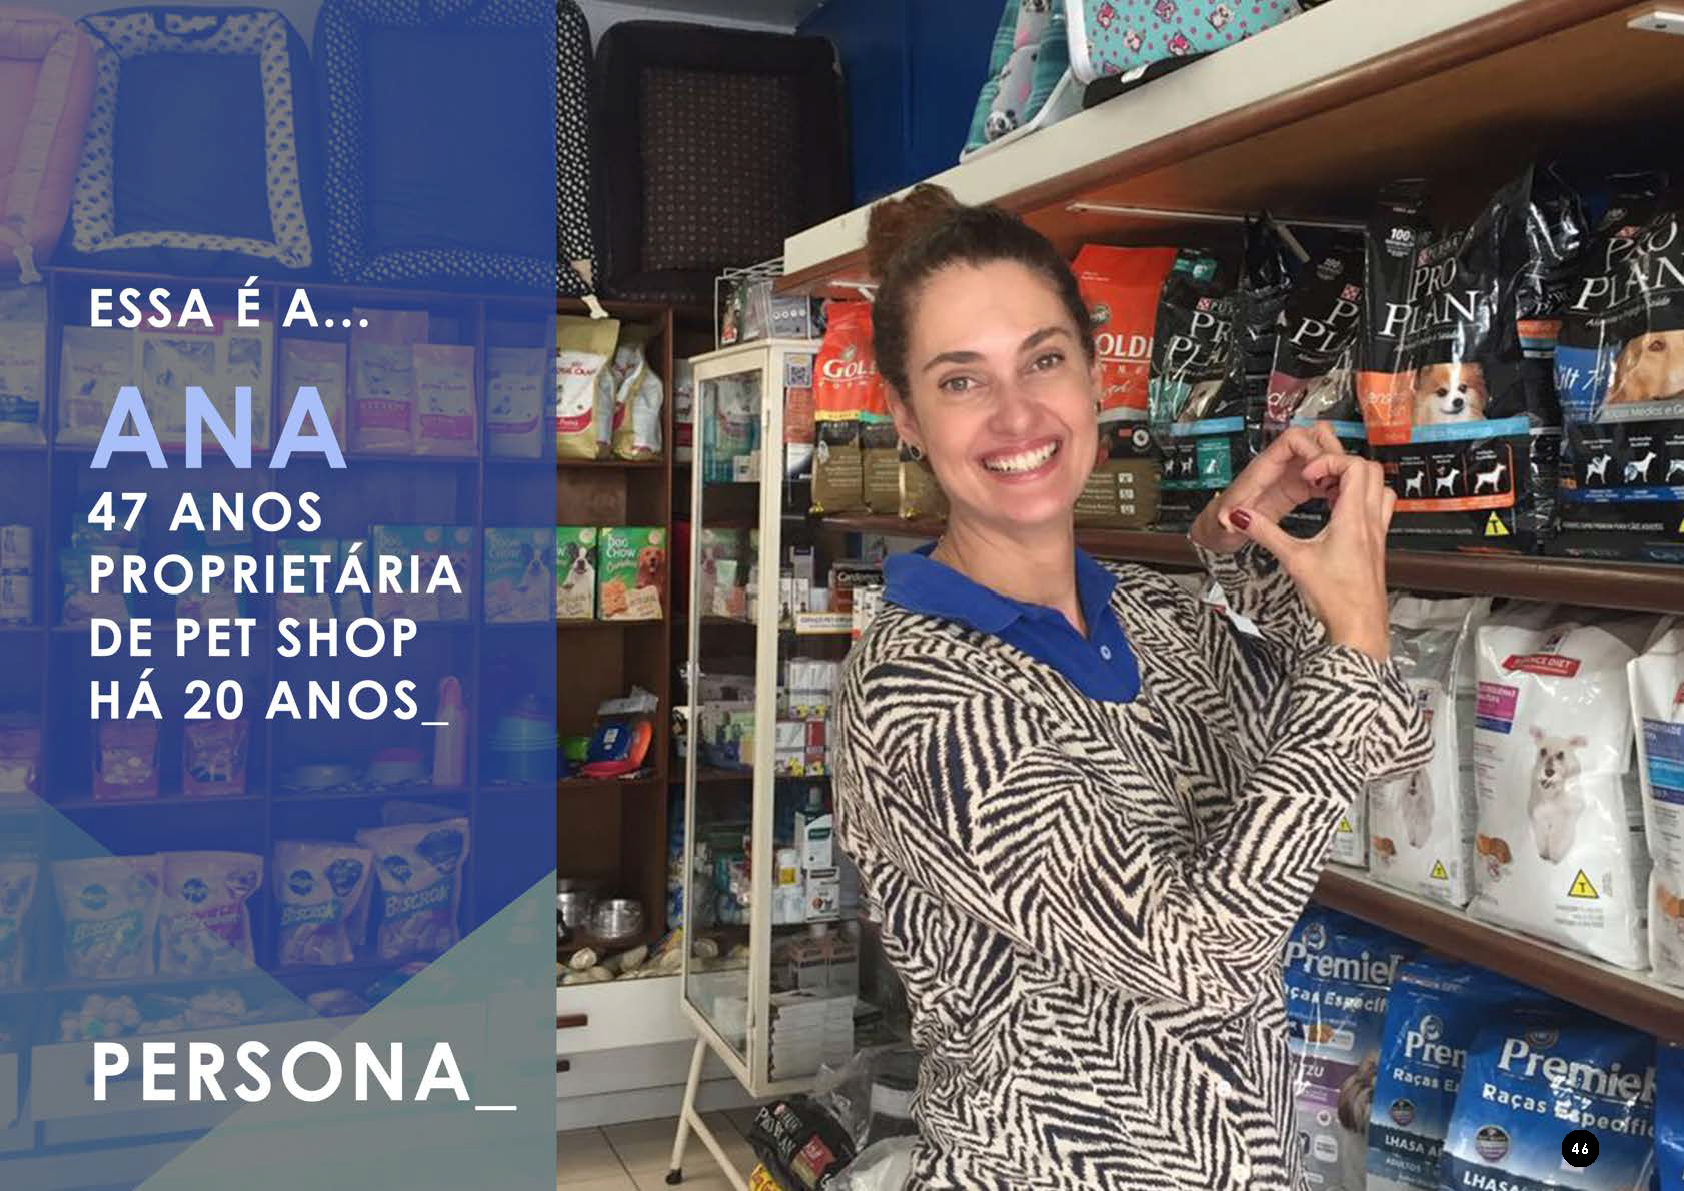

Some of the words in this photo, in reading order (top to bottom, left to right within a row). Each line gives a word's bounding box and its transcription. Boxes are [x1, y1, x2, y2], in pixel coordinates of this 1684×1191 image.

[1408, 257, 1457, 304] PRO
[1378, 290, 1481, 337] PLAN
[1095, 332, 1154, 358] OLD
[1393, 1067, 1439, 1089] Raças
[1481, 1082, 1546, 1114] Raças
[1385, 1134, 1425, 1155] LHASA
